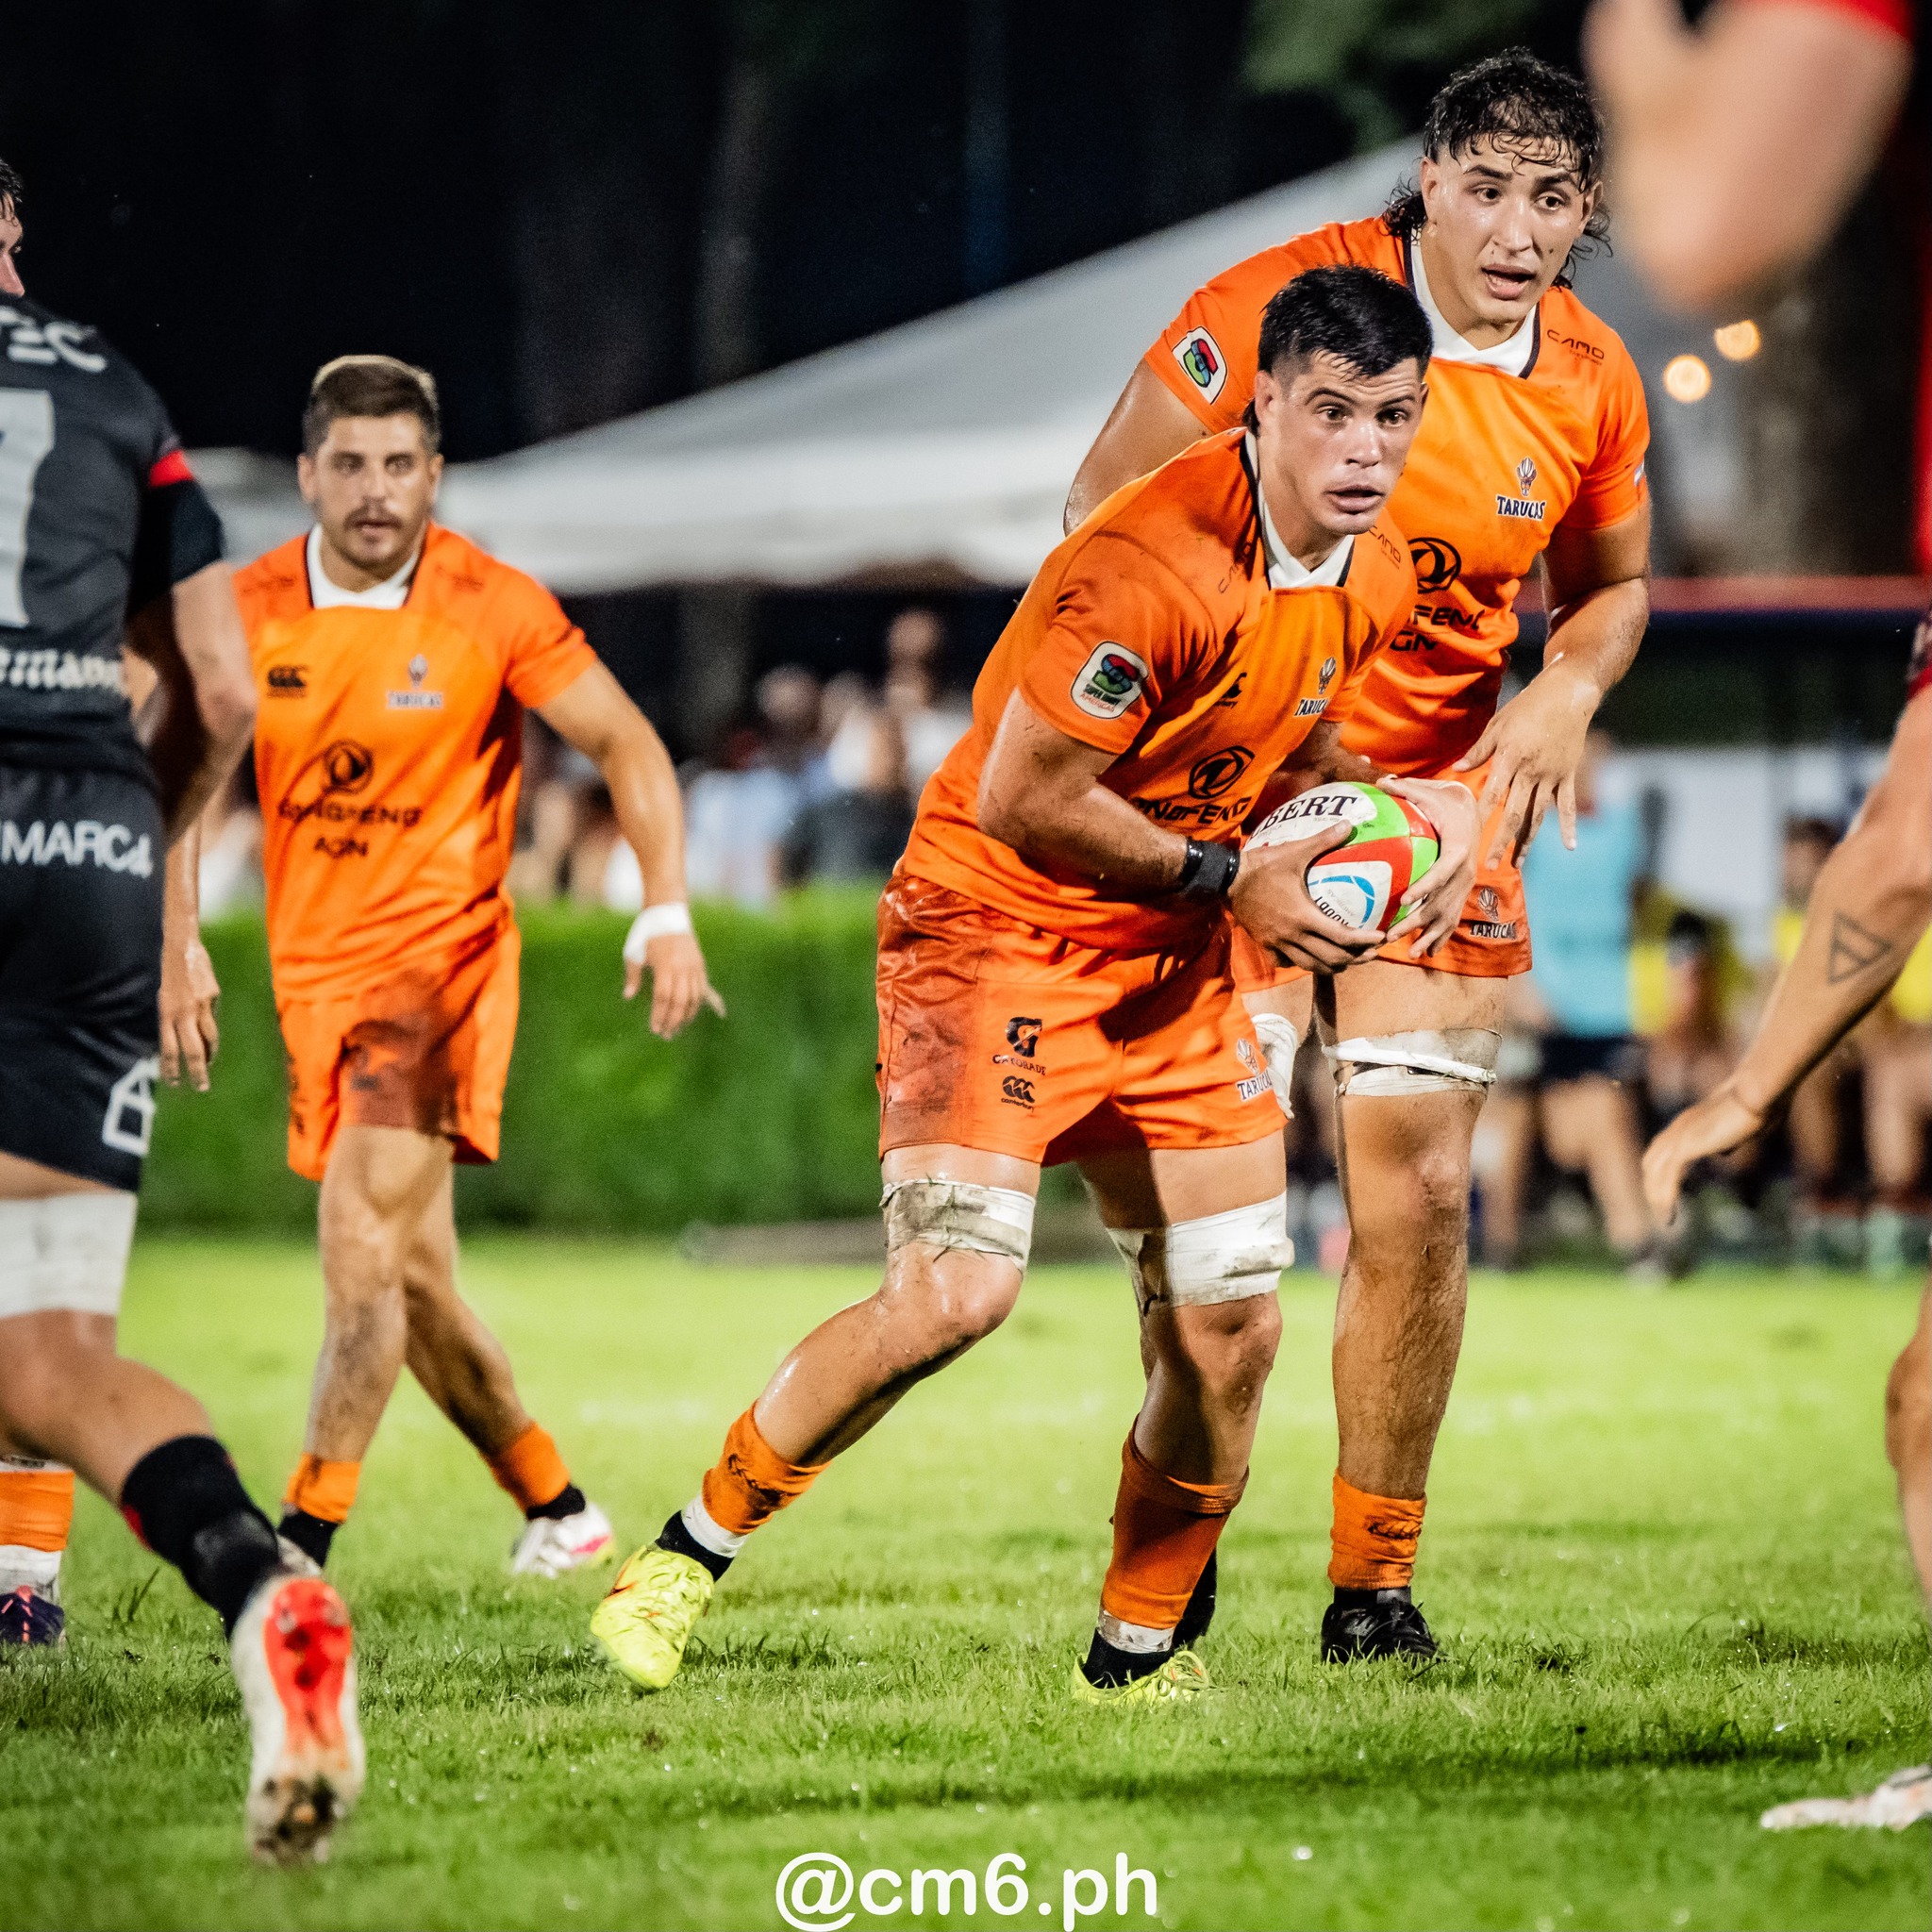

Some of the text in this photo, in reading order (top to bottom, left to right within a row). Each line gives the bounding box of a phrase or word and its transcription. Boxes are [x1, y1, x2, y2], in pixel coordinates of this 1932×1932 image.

[1547, 329, 1605, 359] CAMO
[1496, 494, 1546, 520] TARUCAS
[1293, 698, 1328, 717] TARUC
